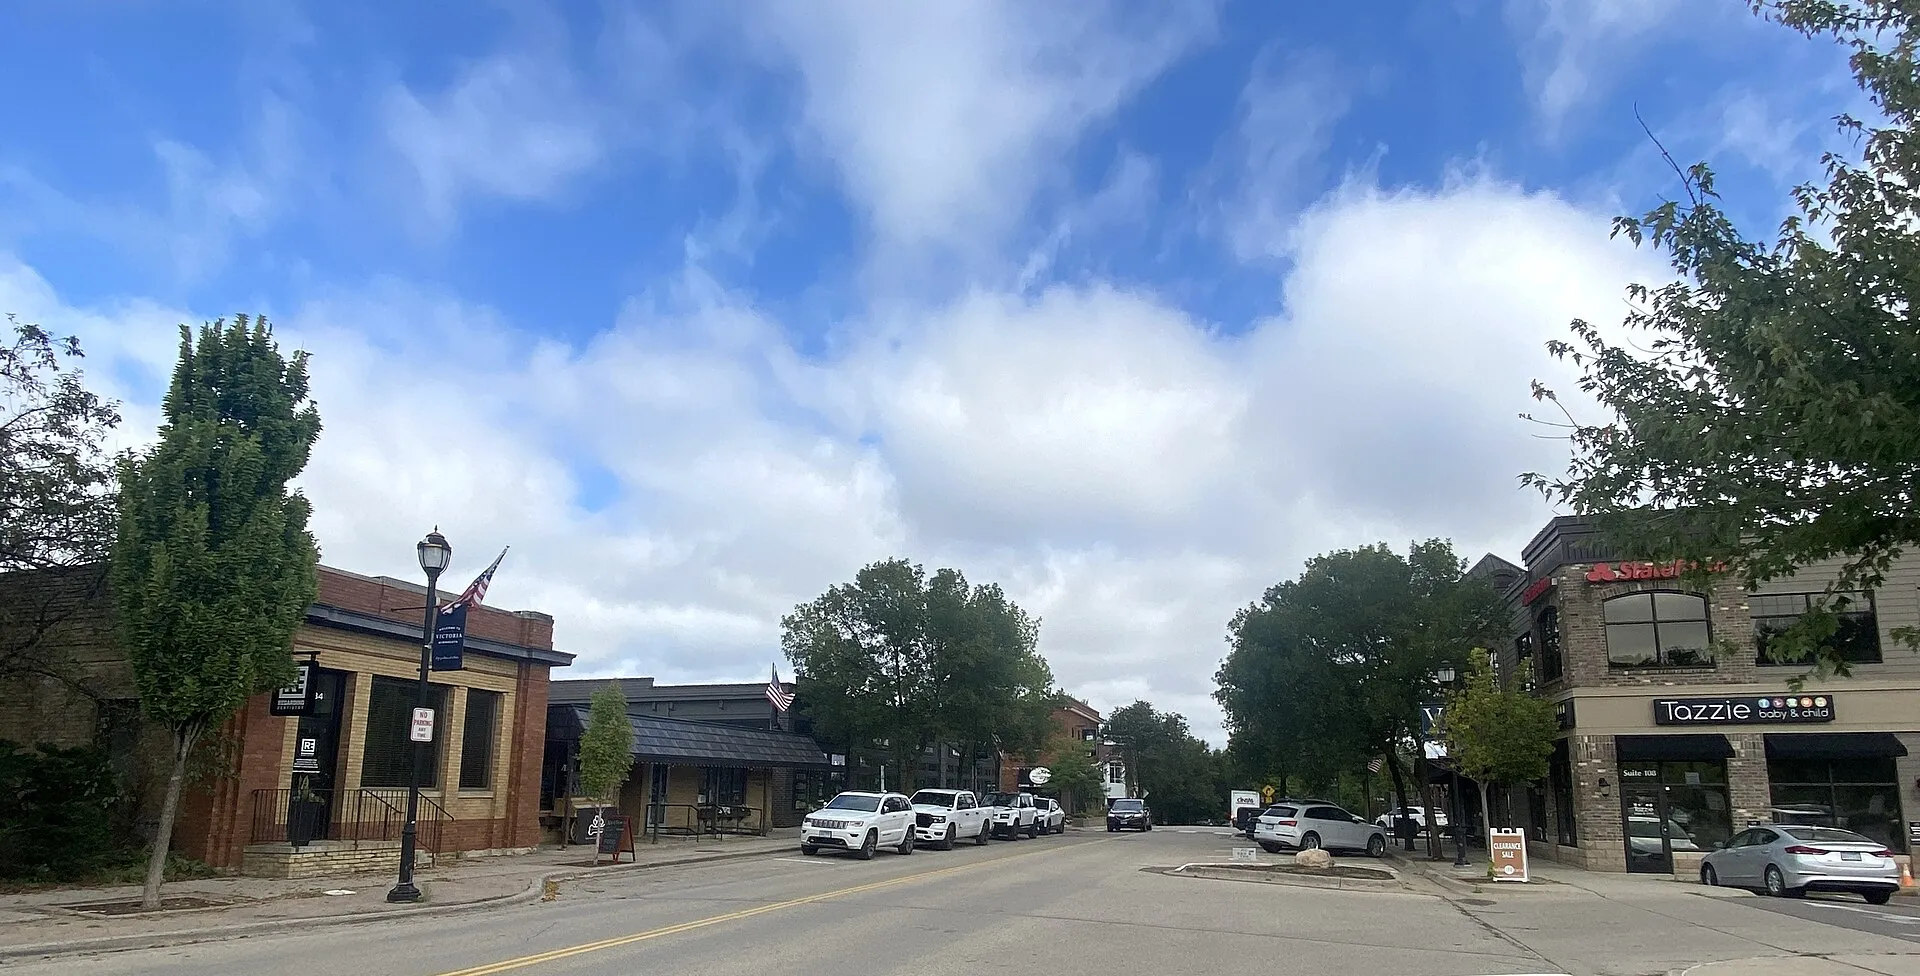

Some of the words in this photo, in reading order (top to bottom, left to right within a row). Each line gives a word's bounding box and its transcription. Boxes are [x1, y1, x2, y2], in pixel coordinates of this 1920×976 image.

[1660, 700, 1751, 720] Tazzie
[1758, 709, 1787, 720] baby
[1790, 708, 1799, 718] &
[1801, 708, 1829, 718] child
[419, 711, 428, 719] NO
[1623, 769, 1642, 777] Suite
[1493, 842, 1522, 850] CLEARANCE
[1501, 850, 1514, 859] SALE
